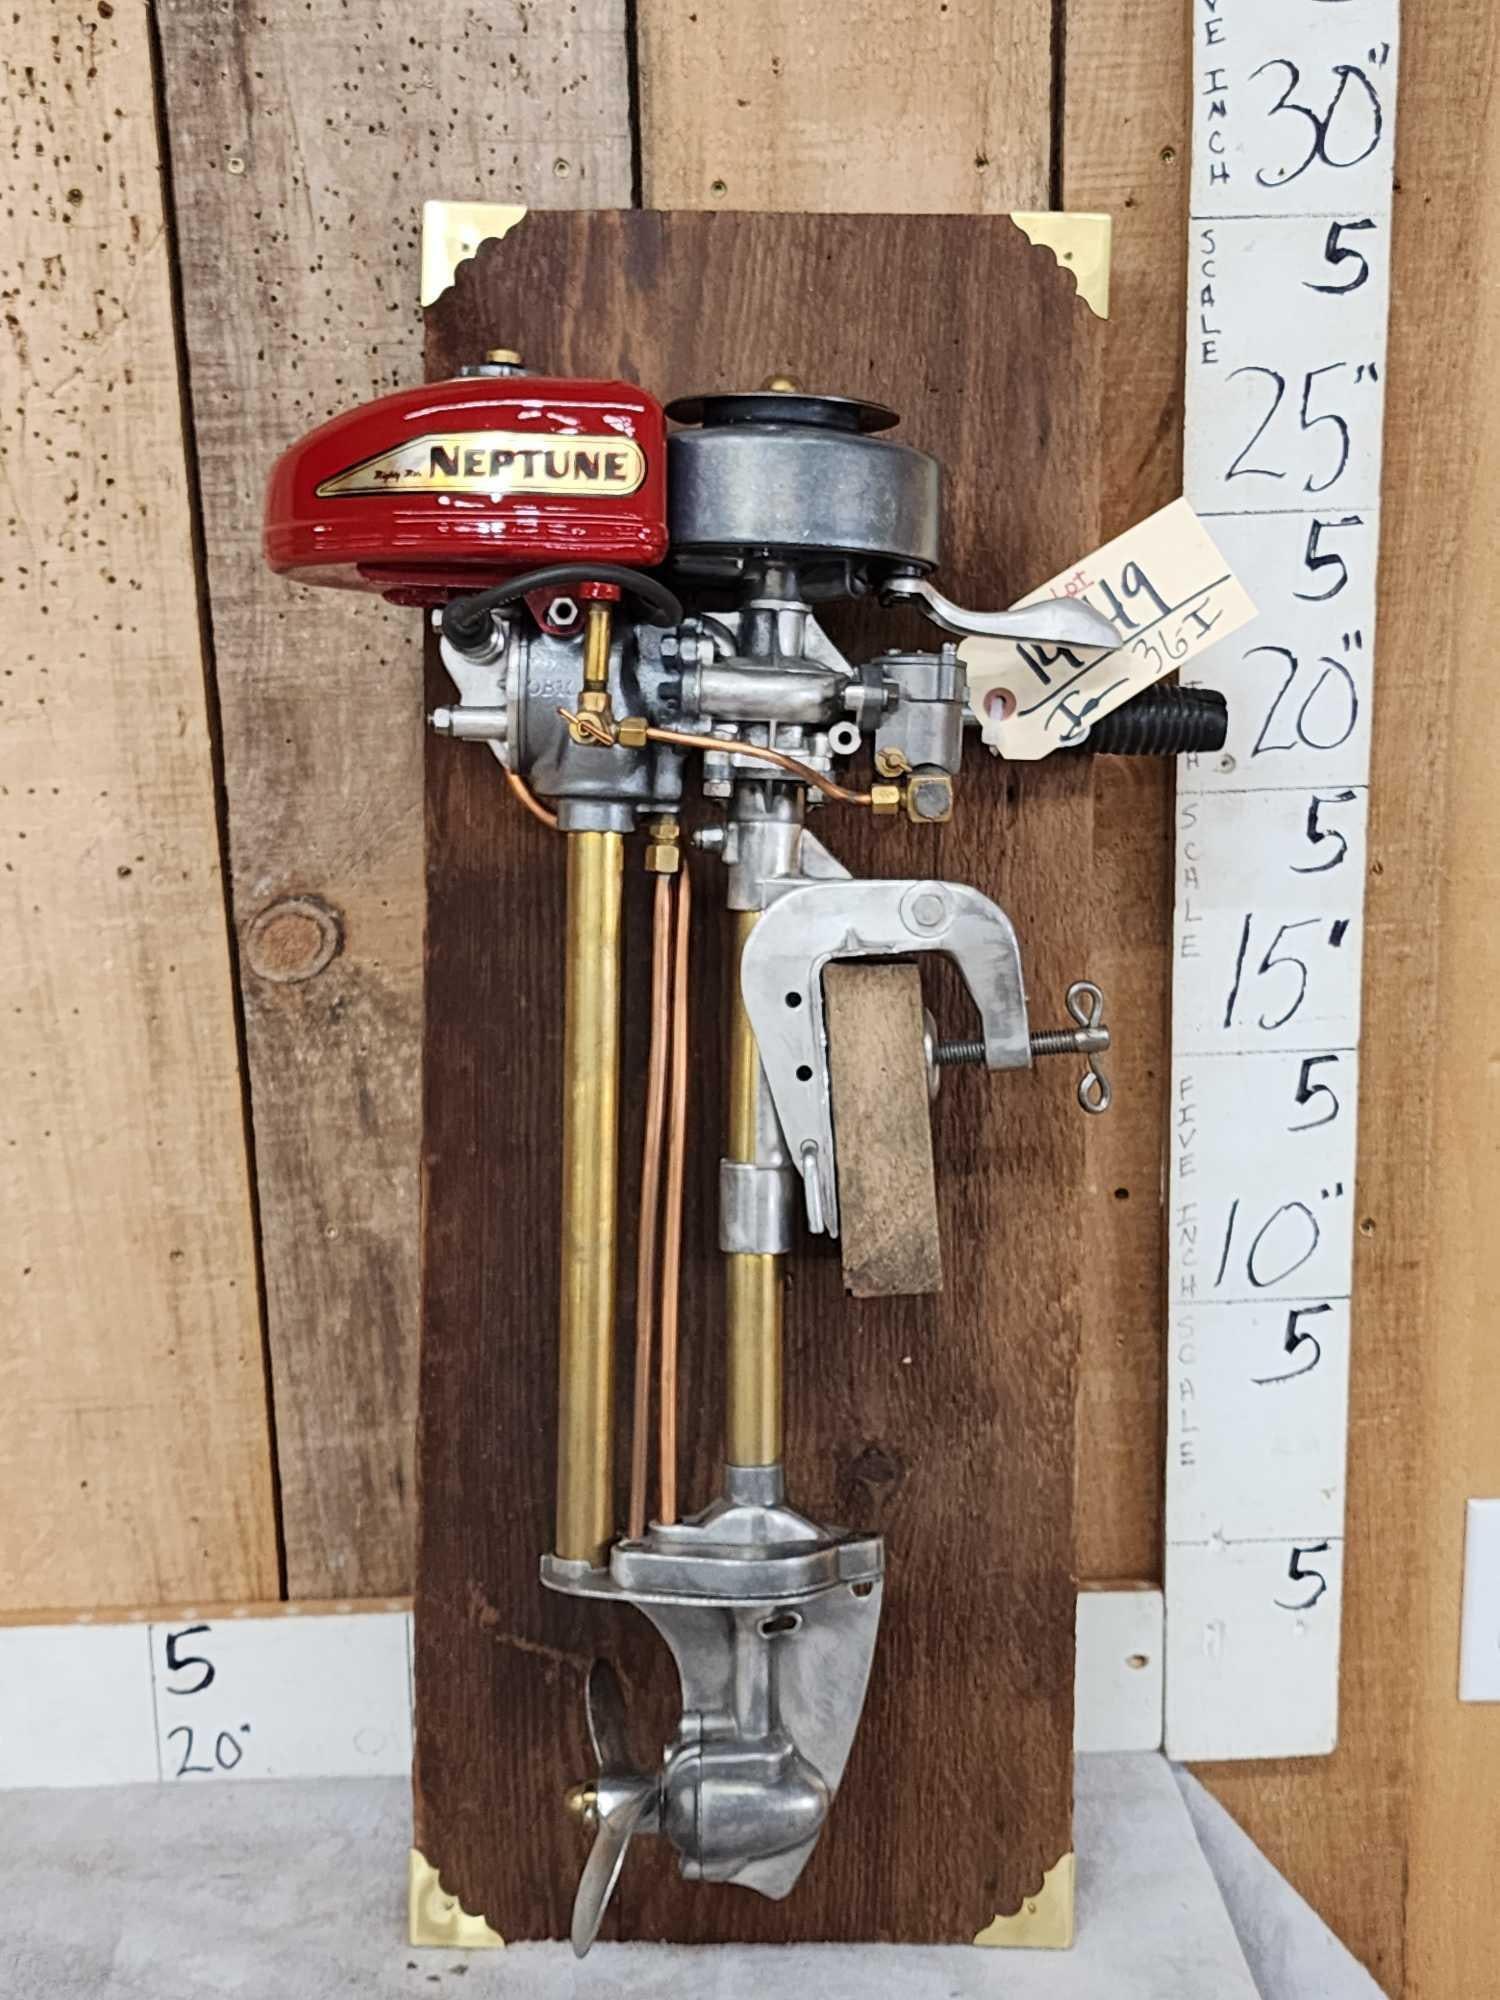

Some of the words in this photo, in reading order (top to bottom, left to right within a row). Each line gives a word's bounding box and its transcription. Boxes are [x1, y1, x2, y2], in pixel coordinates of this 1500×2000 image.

[1302, 219, 1377, 294] 5
[430, 446, 629, 481] NEPTUNE
[1293, 515, 1364, 601] 5
[1290, 790, 1357, 873] 5
[1288, 1055, 1339, 1132] 5
[1251, 1303, 1331, 1385] 5
[1274, 1542, 1330, 1609] 5
[166, 1625, 215, 1695] 5
